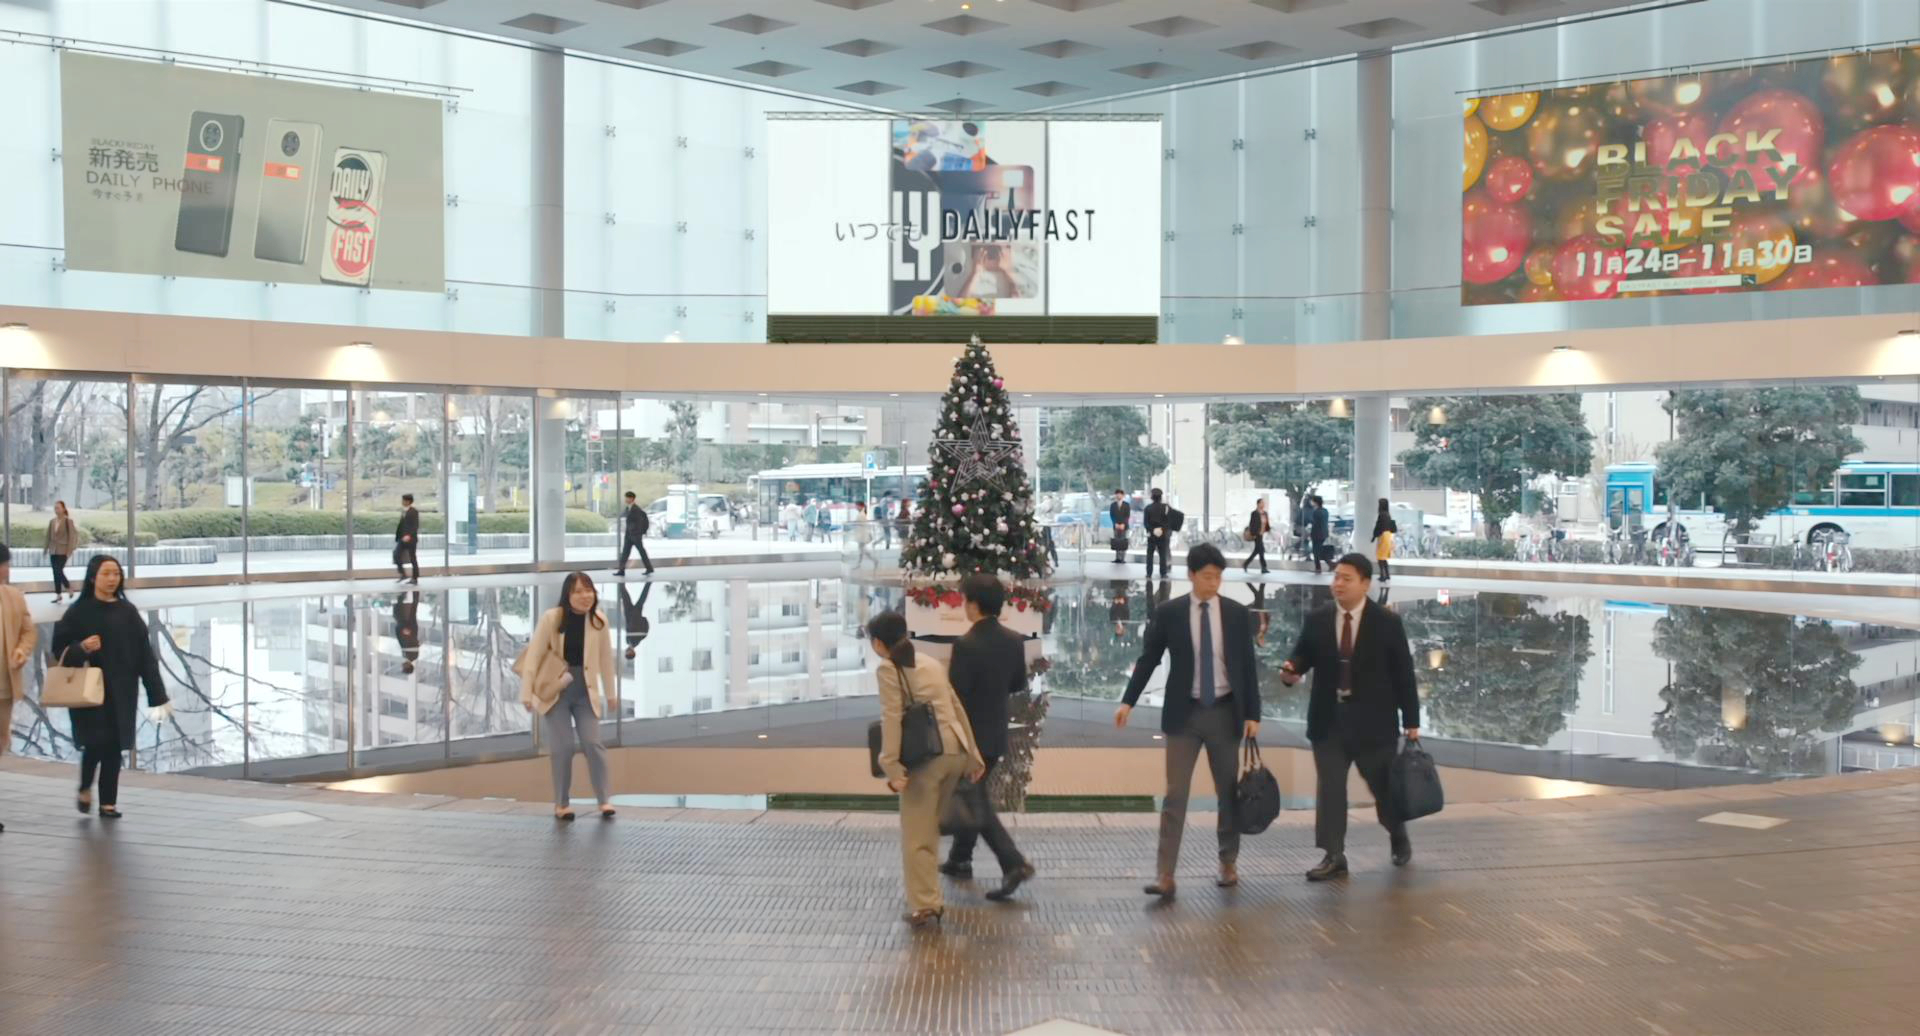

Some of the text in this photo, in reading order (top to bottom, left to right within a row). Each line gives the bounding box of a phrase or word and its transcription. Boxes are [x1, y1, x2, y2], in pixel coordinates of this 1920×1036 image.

[88, 147, 159, 173] 新発売
[1596, 128, 1784, 178] BLACK
[86, 170, 214, 194] DAILY PHONE
[331, 166, 370, 201] DAILY
[1596, 164, 1801, 215] FRIDAY
[834, 208, 1096, 242] いつでも DAILYFAST
[1595, 207, 1733, 250] SALE
[334, 227, 371, 264] FAST
